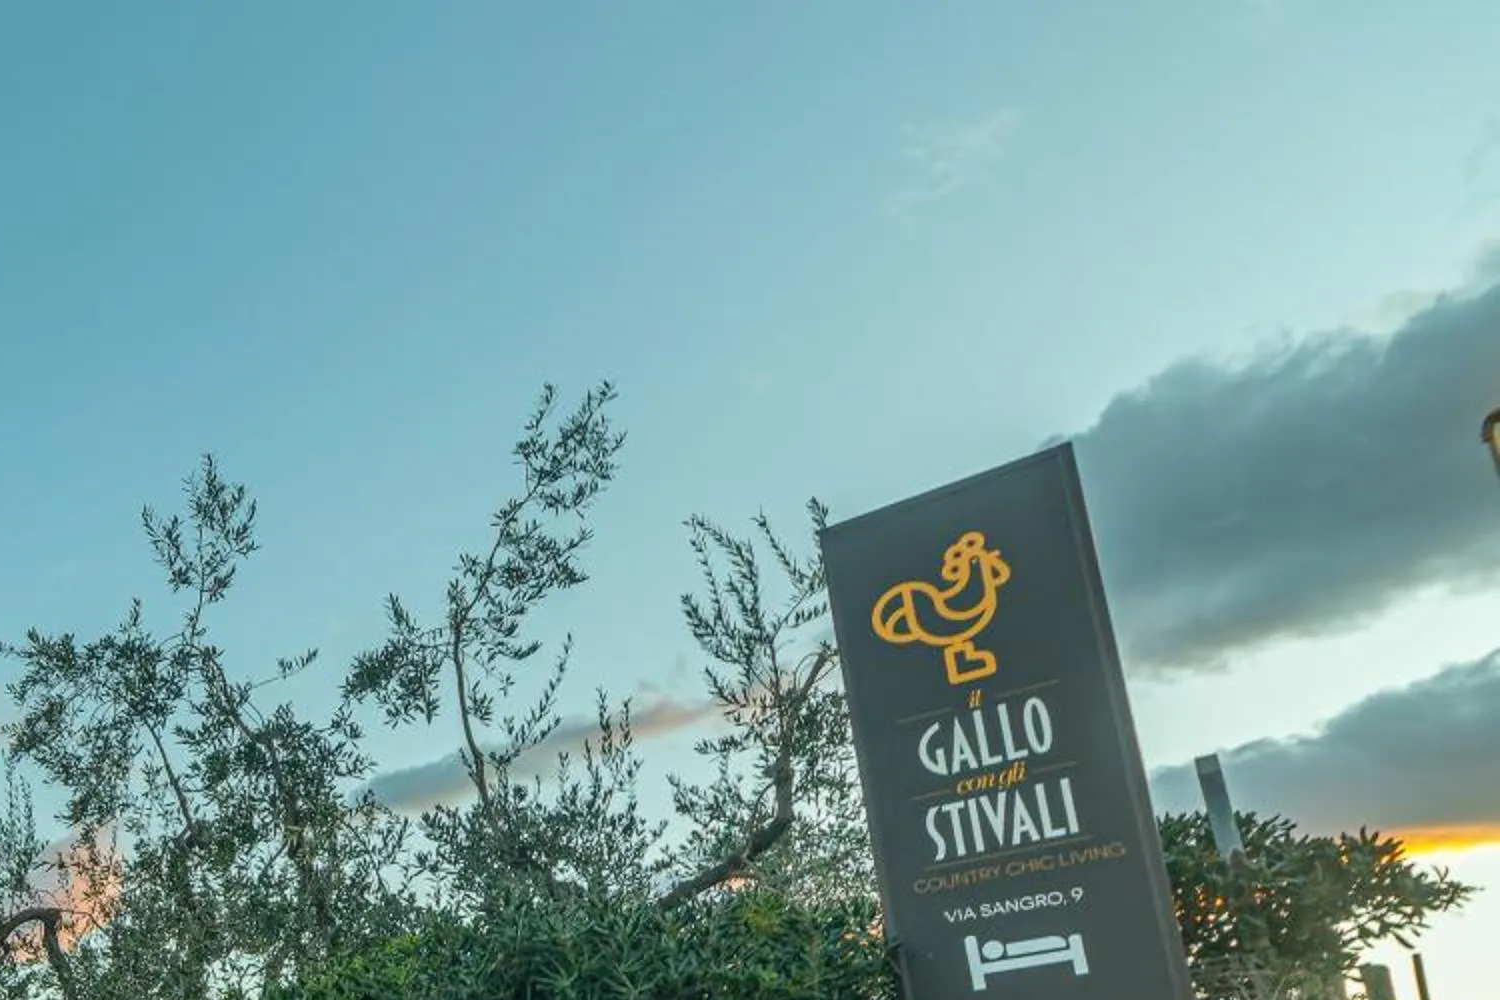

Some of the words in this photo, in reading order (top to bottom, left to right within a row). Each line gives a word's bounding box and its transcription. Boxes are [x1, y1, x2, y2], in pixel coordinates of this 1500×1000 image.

[918, 697, 1052, 775] GALLO
[956, 773, 996, 796] con
[925, 778, 1079, 861] STIVALI
[913, 866, 1000, 894] COUNTRY
[1004, 855, 1056, 878] CHIC
[1059, 842, 1126, 867] LIVING
[943, 908, 977, 923] VIA
[980, 891, 1067, 917] SANGRO,
[1070, 887, 1084, 901] 9
